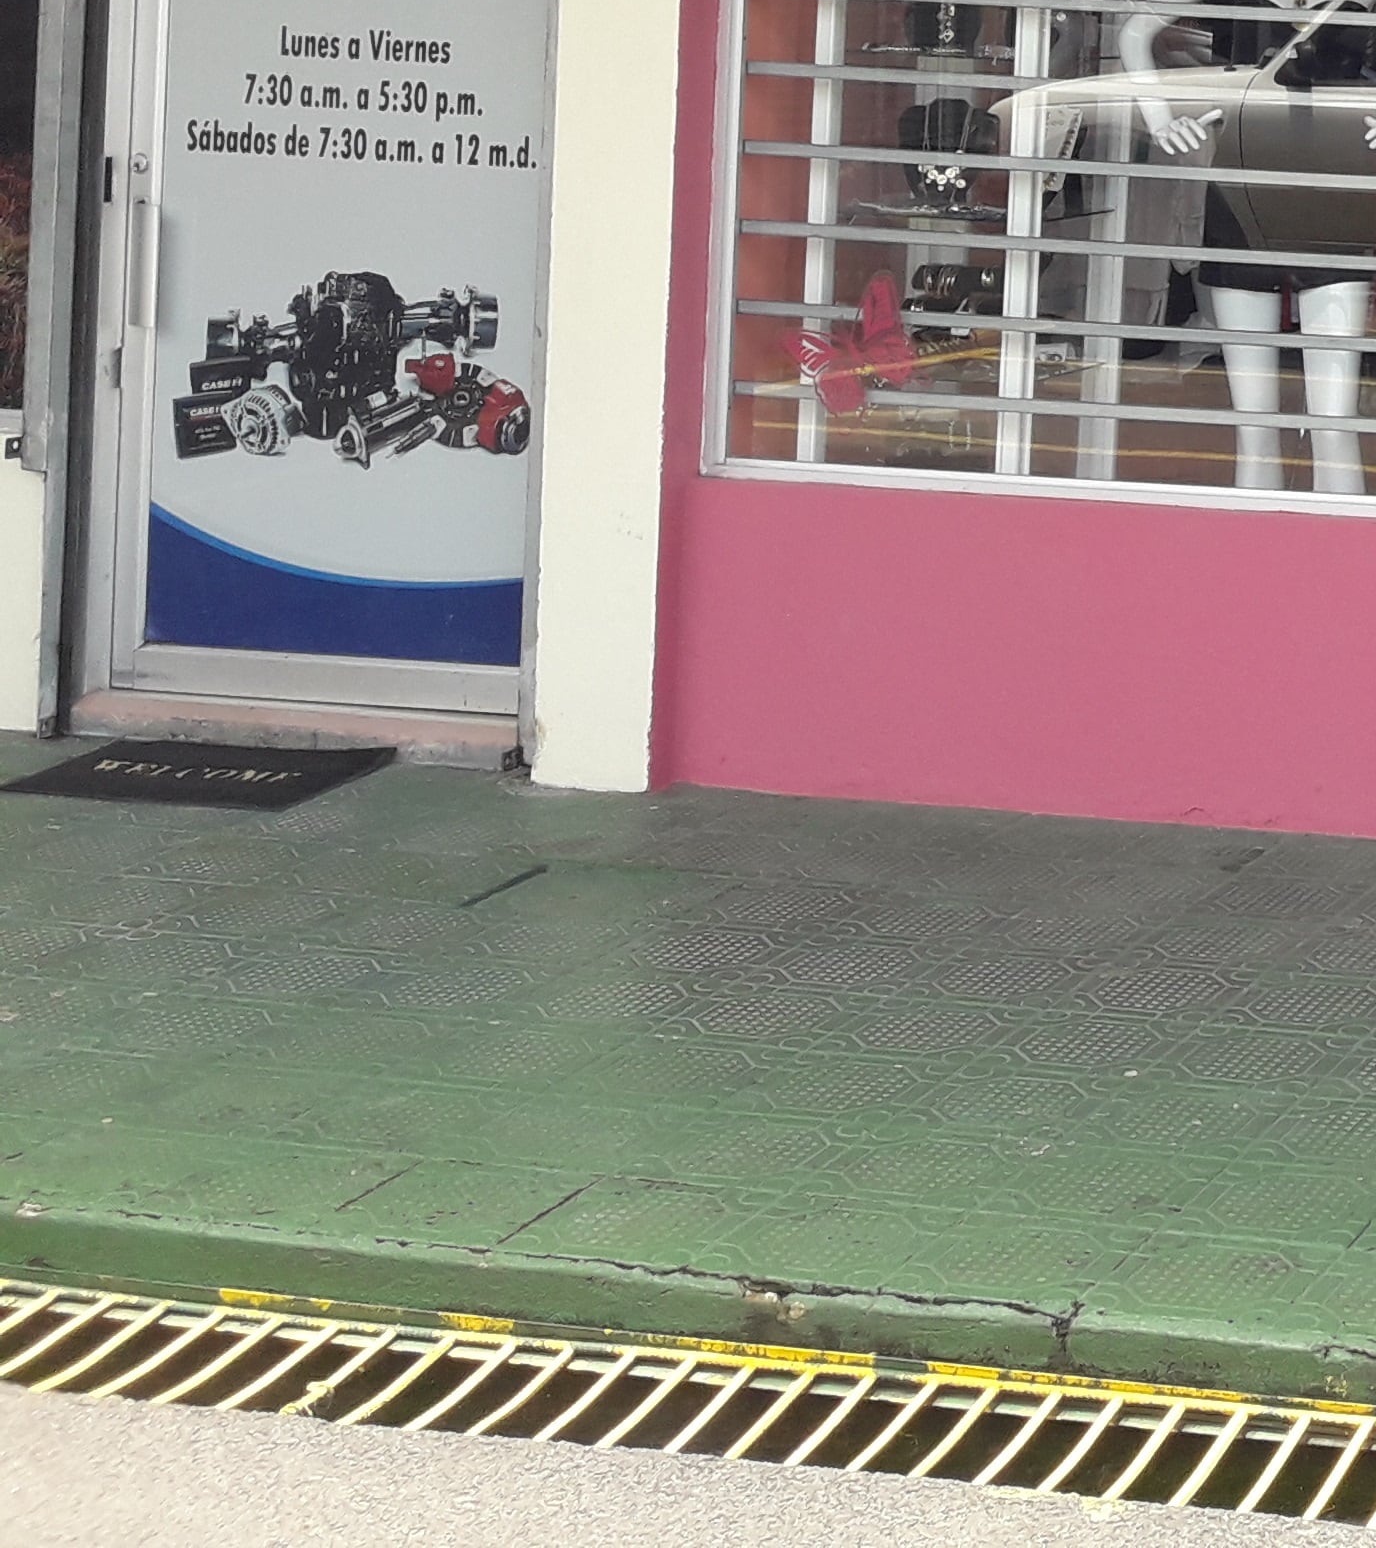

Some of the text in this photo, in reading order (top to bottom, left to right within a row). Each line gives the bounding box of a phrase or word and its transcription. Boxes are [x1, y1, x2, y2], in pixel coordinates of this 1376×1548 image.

[281, 25, 451, 64] Lunes a Viernes
[244, 73, 483, 122] 7:30 a.m. a 5:30 p.m.
[187, 119, 537, 169] Sábados de 7:30 a.m. a 12 m.d.
